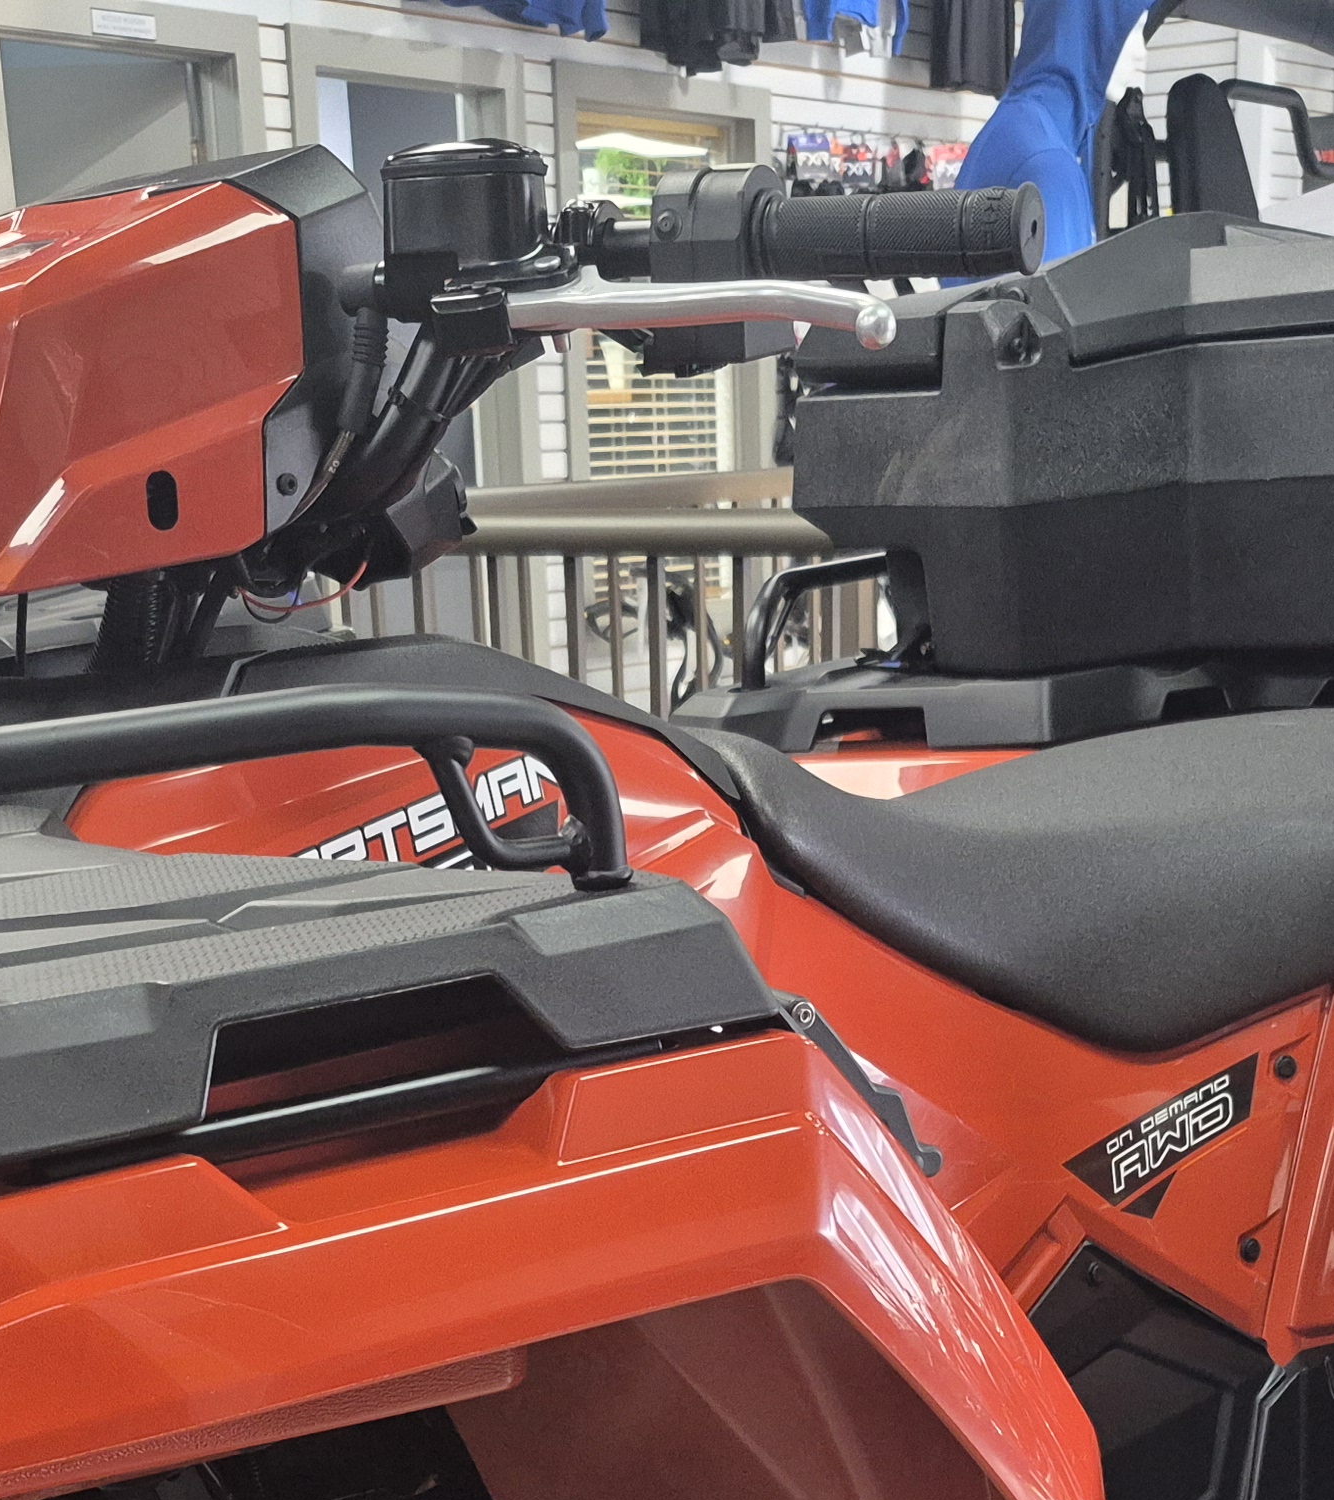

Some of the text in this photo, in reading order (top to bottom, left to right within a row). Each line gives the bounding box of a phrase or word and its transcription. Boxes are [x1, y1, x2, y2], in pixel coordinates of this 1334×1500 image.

[797, 151, 829, 167] FXR
[843, 162, 873, 177] FXR
[1140, 1074, 1230, 1134] DEMAND
[1111, 1093, 1233, 1194] AWD
